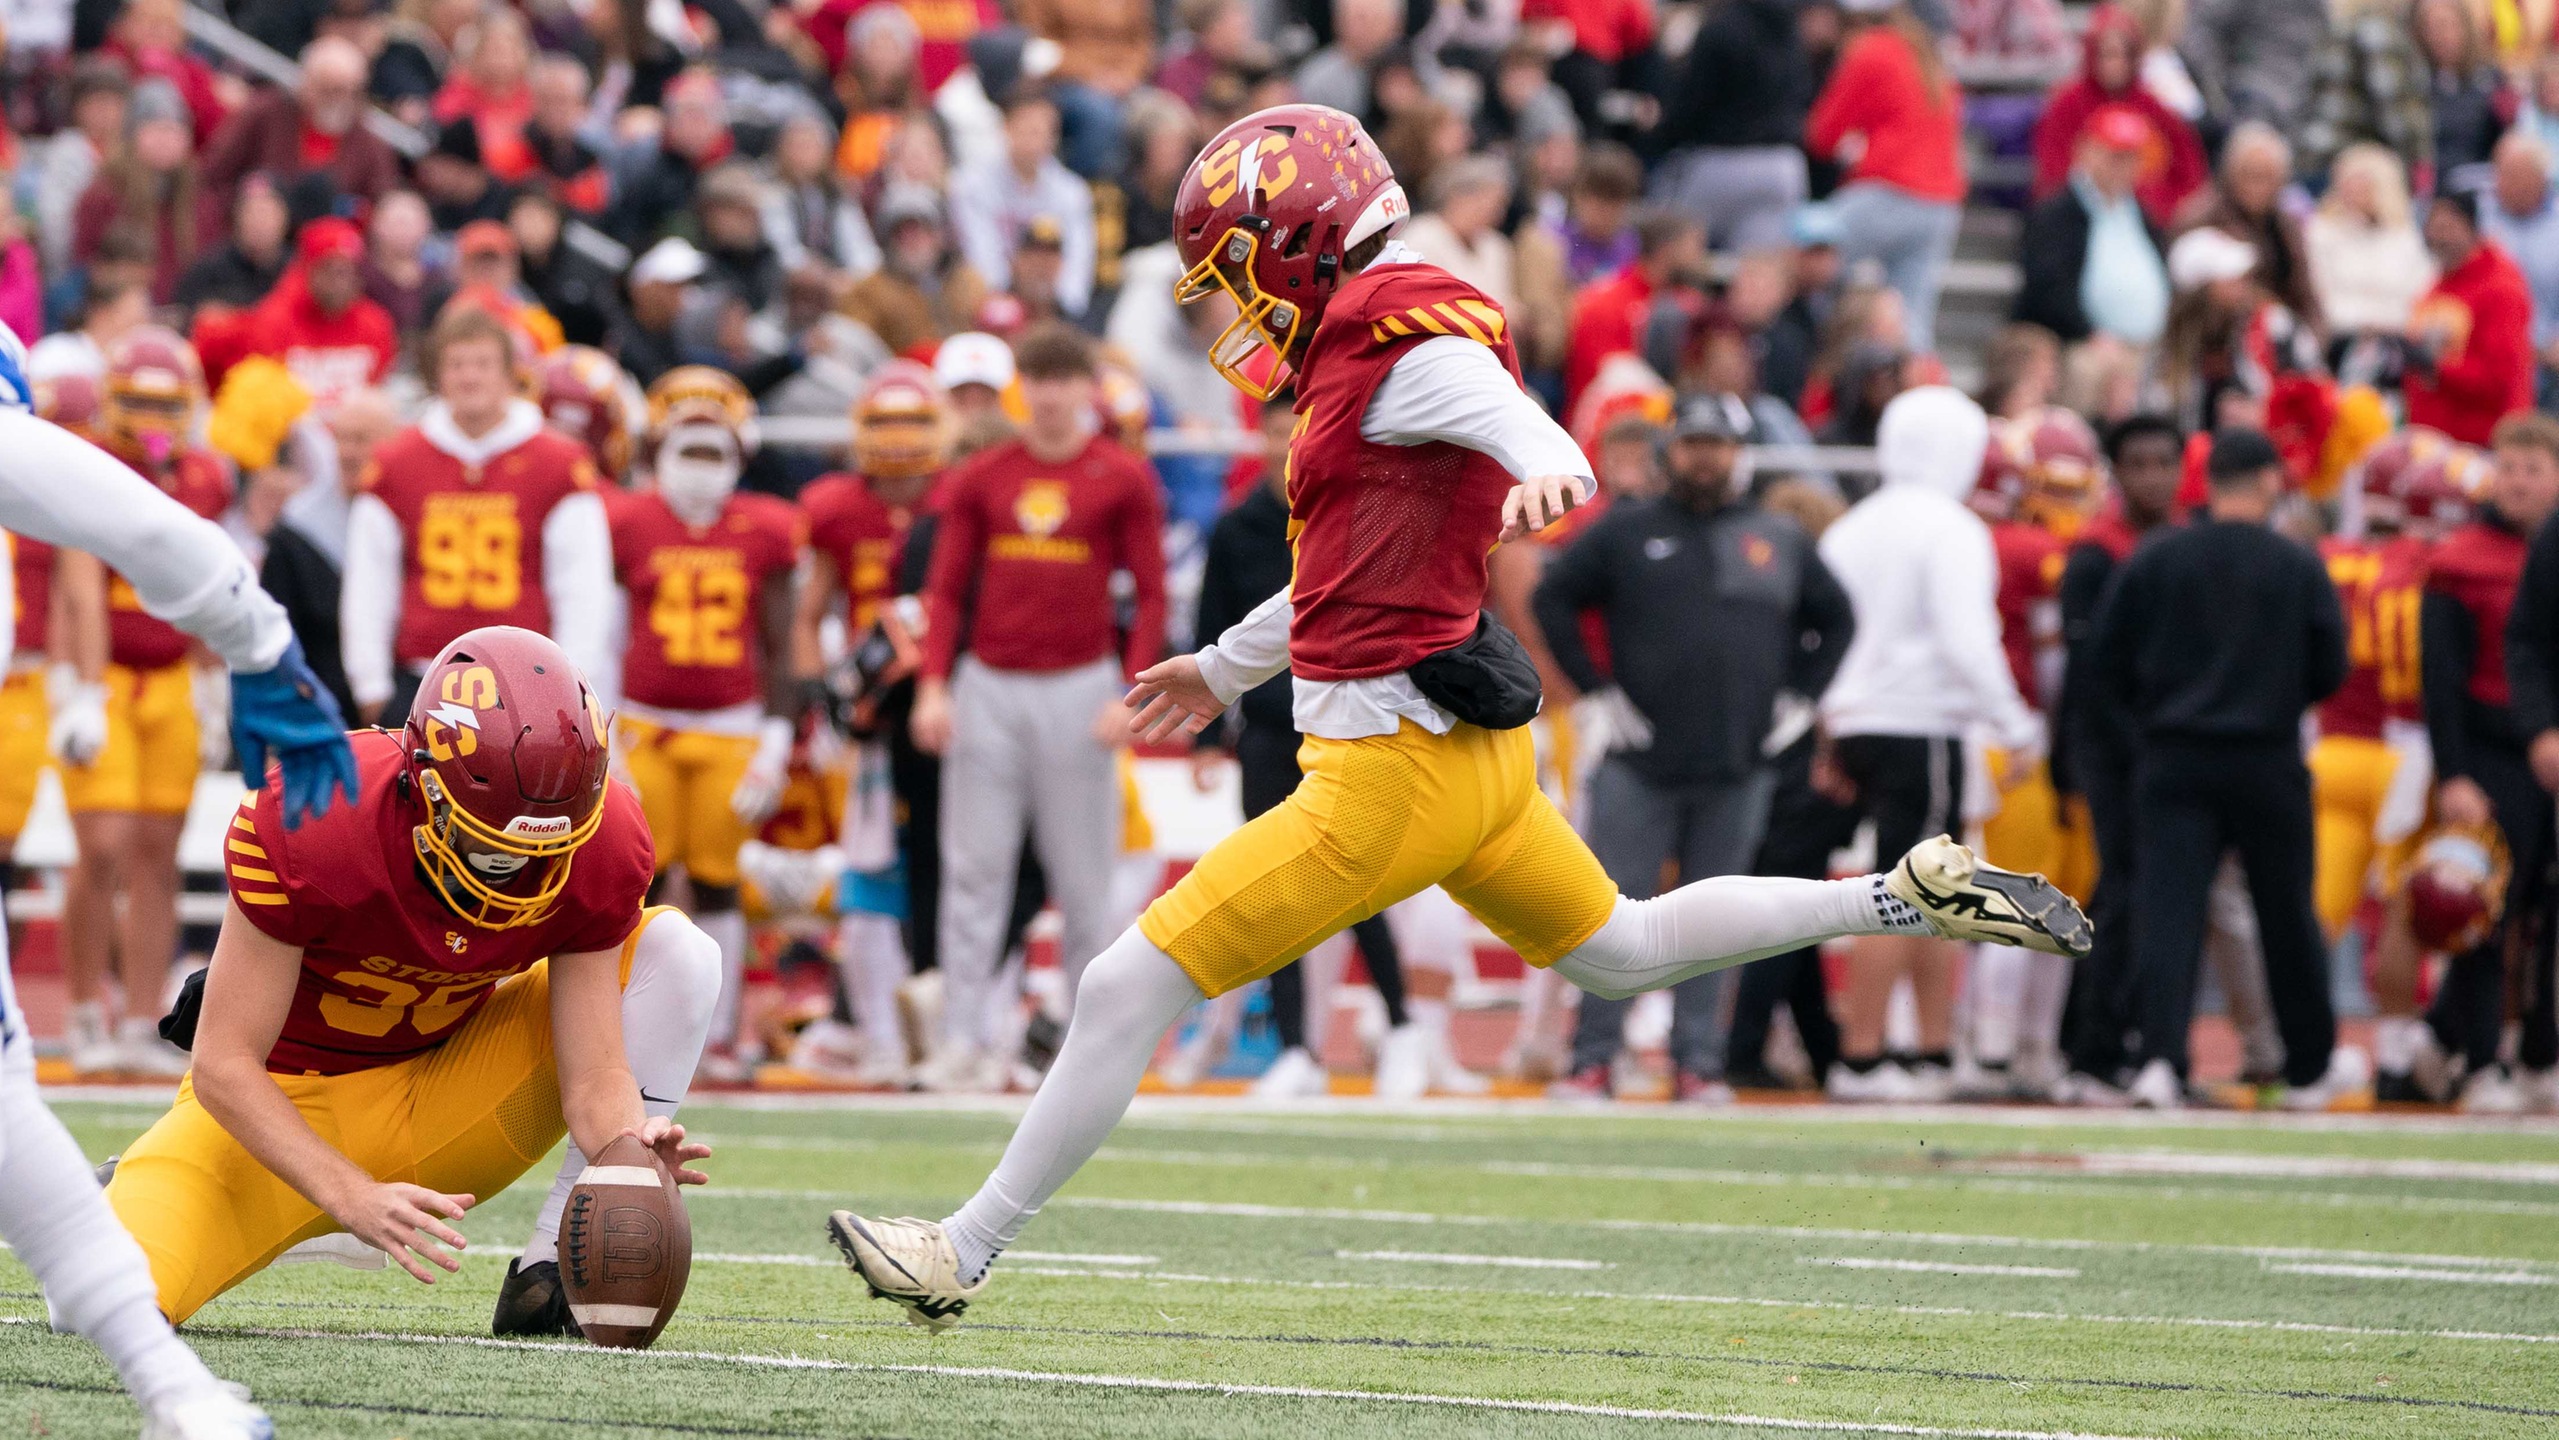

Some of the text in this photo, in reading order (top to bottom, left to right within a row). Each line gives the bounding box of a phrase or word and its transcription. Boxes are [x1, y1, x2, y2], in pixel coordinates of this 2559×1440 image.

[1200, 134, 1299, 209] SC
[420, 516, 521, 609] 99
[649, 564, 750, 667] 42
[517, 821, 567, 833] Riddell
[445, 931, 468, 954] SC
